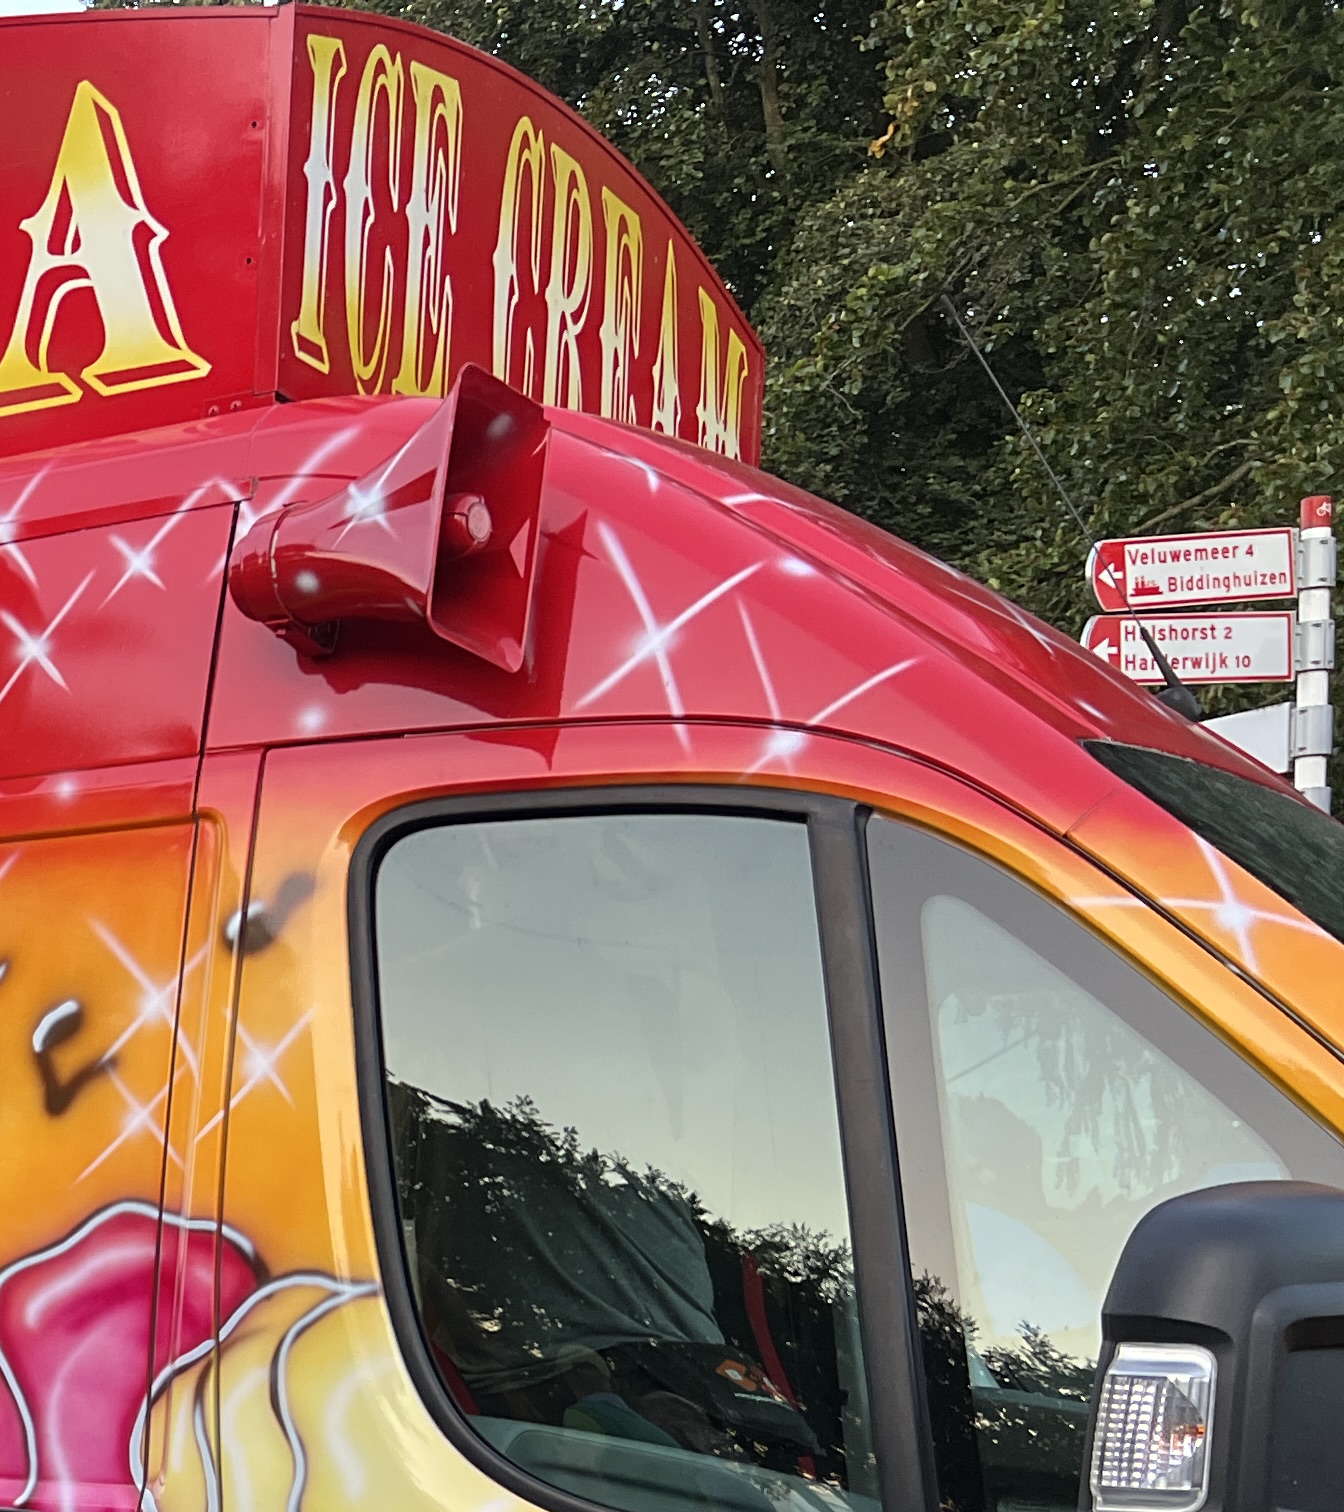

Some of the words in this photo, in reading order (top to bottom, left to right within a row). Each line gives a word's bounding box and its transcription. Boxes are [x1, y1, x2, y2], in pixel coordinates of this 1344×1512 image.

[291, 34, 464, 398] ICE
[492, 116, 749, 462] CREAM
[1127, 544, 1240, 567] Veluwemeer
[1245, 543, 1254, 558] 4
[1167, 570, 1288, 593] Biddinghuizen
[1124, 624, 1217, 642] Hlshorst
[1223, 626, 1233, 641] 2
[1124, 652, 1229, 675] Harerwijk
[1235, 654, 1252, 669] 10
